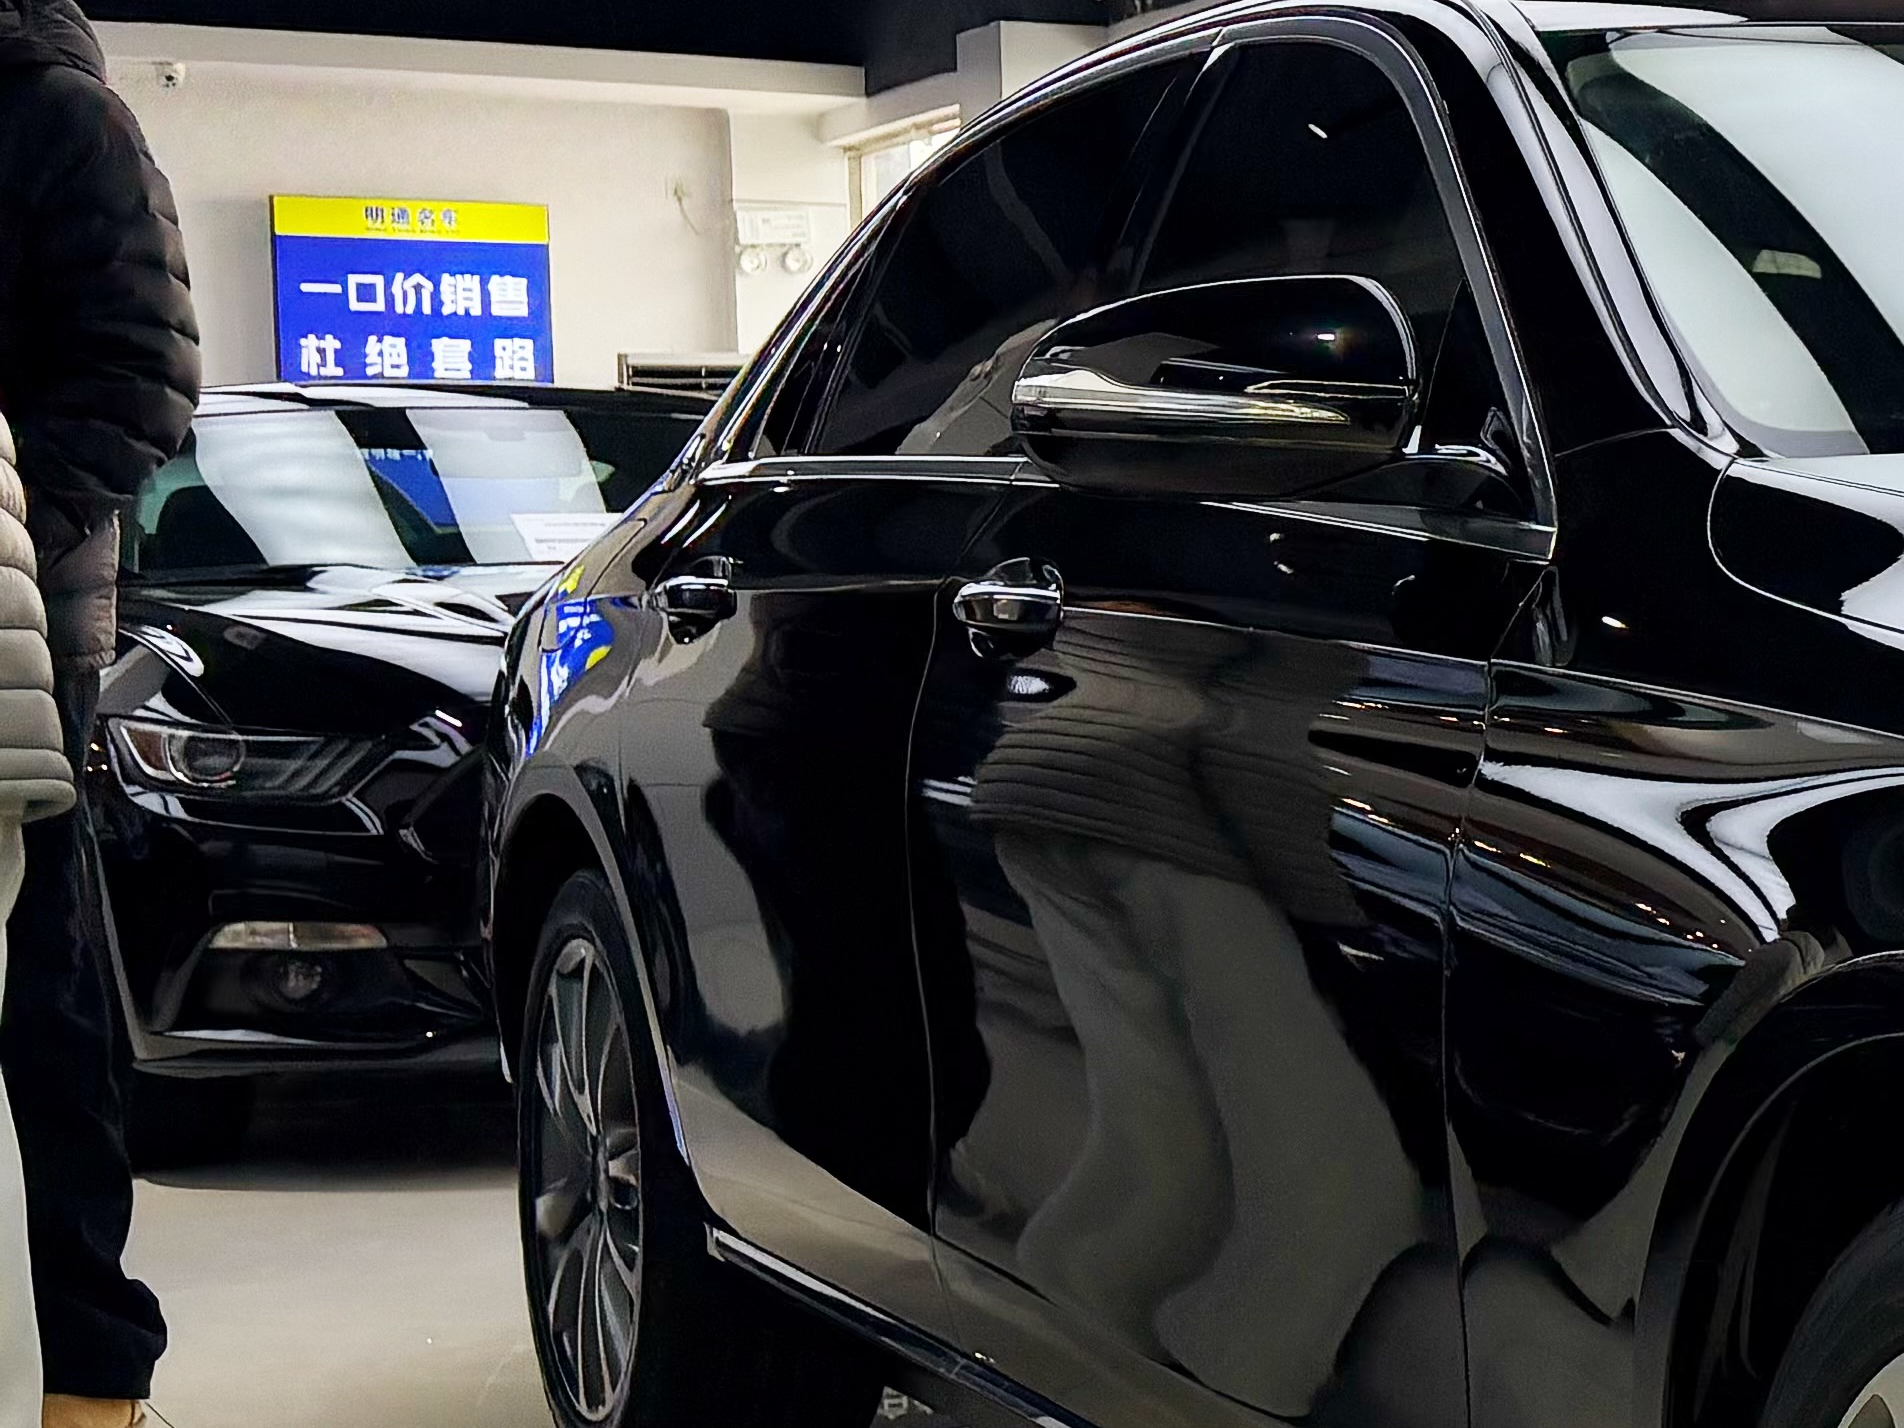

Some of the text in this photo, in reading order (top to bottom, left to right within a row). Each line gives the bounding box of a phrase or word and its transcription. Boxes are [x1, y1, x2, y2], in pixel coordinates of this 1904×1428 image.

[299, 272, 530, 317] 一口价销售
[299, 333, 536, 380] 杜绝套路
